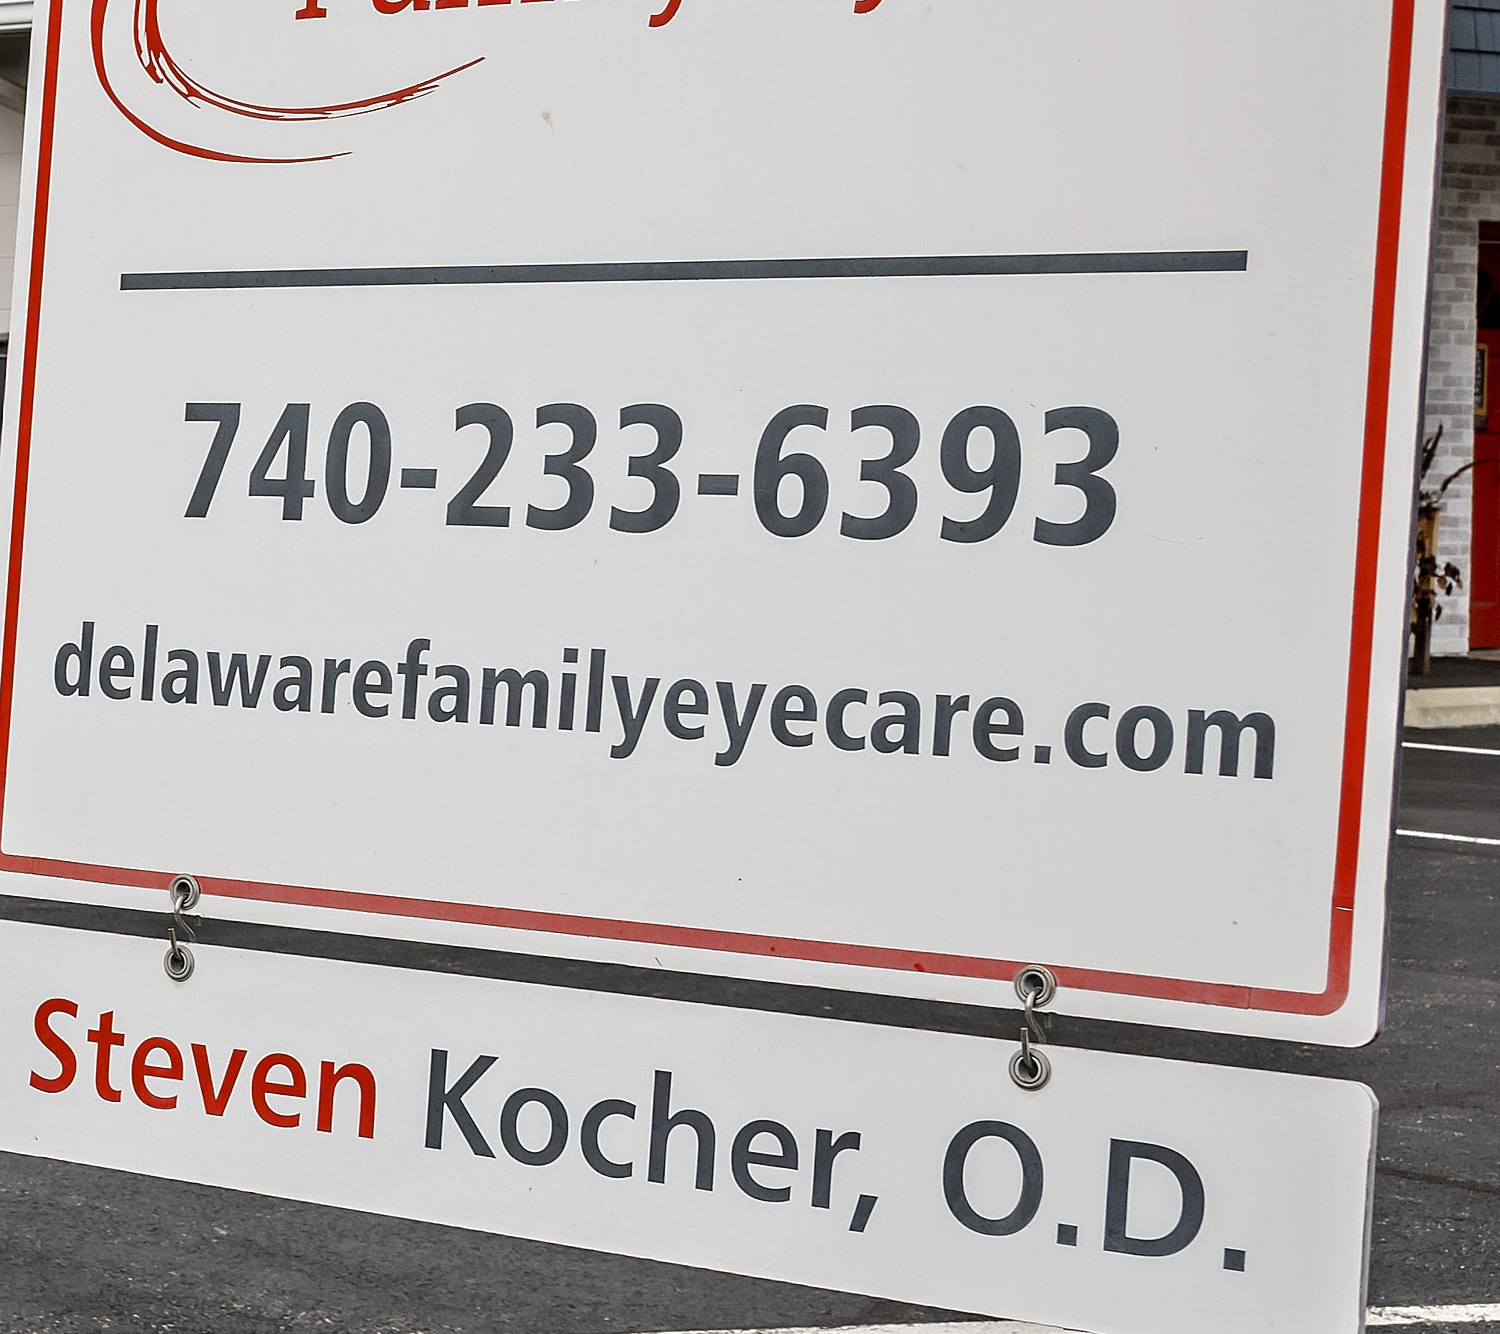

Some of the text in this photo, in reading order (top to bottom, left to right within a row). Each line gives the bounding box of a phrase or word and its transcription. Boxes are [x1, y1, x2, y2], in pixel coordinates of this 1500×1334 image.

[183, 401, 1120, 547] 740-233-6393
[54, 621, 1276, 780] delawarefamilyeyecare.com
[29, 998, 1246, 1273] Steven Kocher, O.D.
